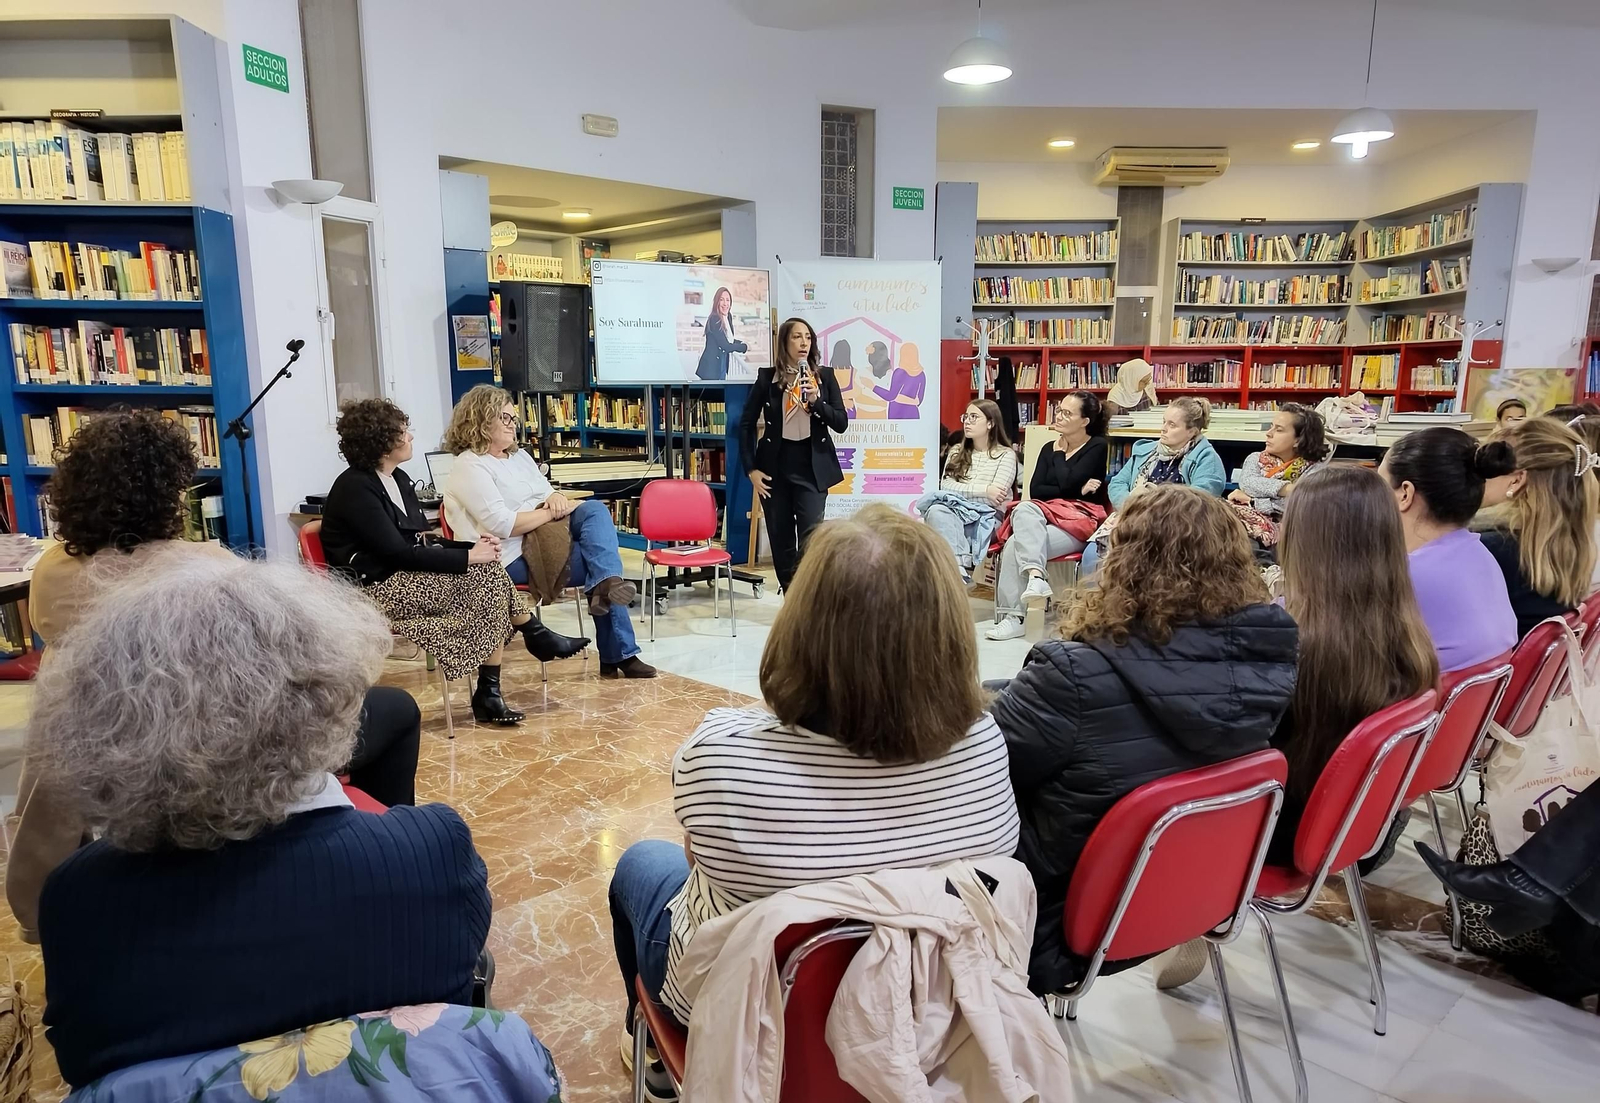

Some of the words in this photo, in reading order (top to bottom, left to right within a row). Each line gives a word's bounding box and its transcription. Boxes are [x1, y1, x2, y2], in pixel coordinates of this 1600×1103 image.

[246, 50, 285, 73] SECCION
[247, 64, 287, 87] ADULTOS
[895, 189, 923, 199] SECCION
[895, 198, 922, 207] JUVENIL
[837, 279, 928, 294] caminamos
[883, 293, 922, 312] lado
[599, 316, 615, 330] Soy
[618, 317, 664, 328] Sarahmar
[848, 423, 887, 433] MUNICIPAL
[889, 423, 899, 433] DE
[833, 433, 860, 444] MACIÓN
[862, 434, 868, 444] A
[870, 434, 879, 444] LA
[881, 433, 905, 444] MUJER
